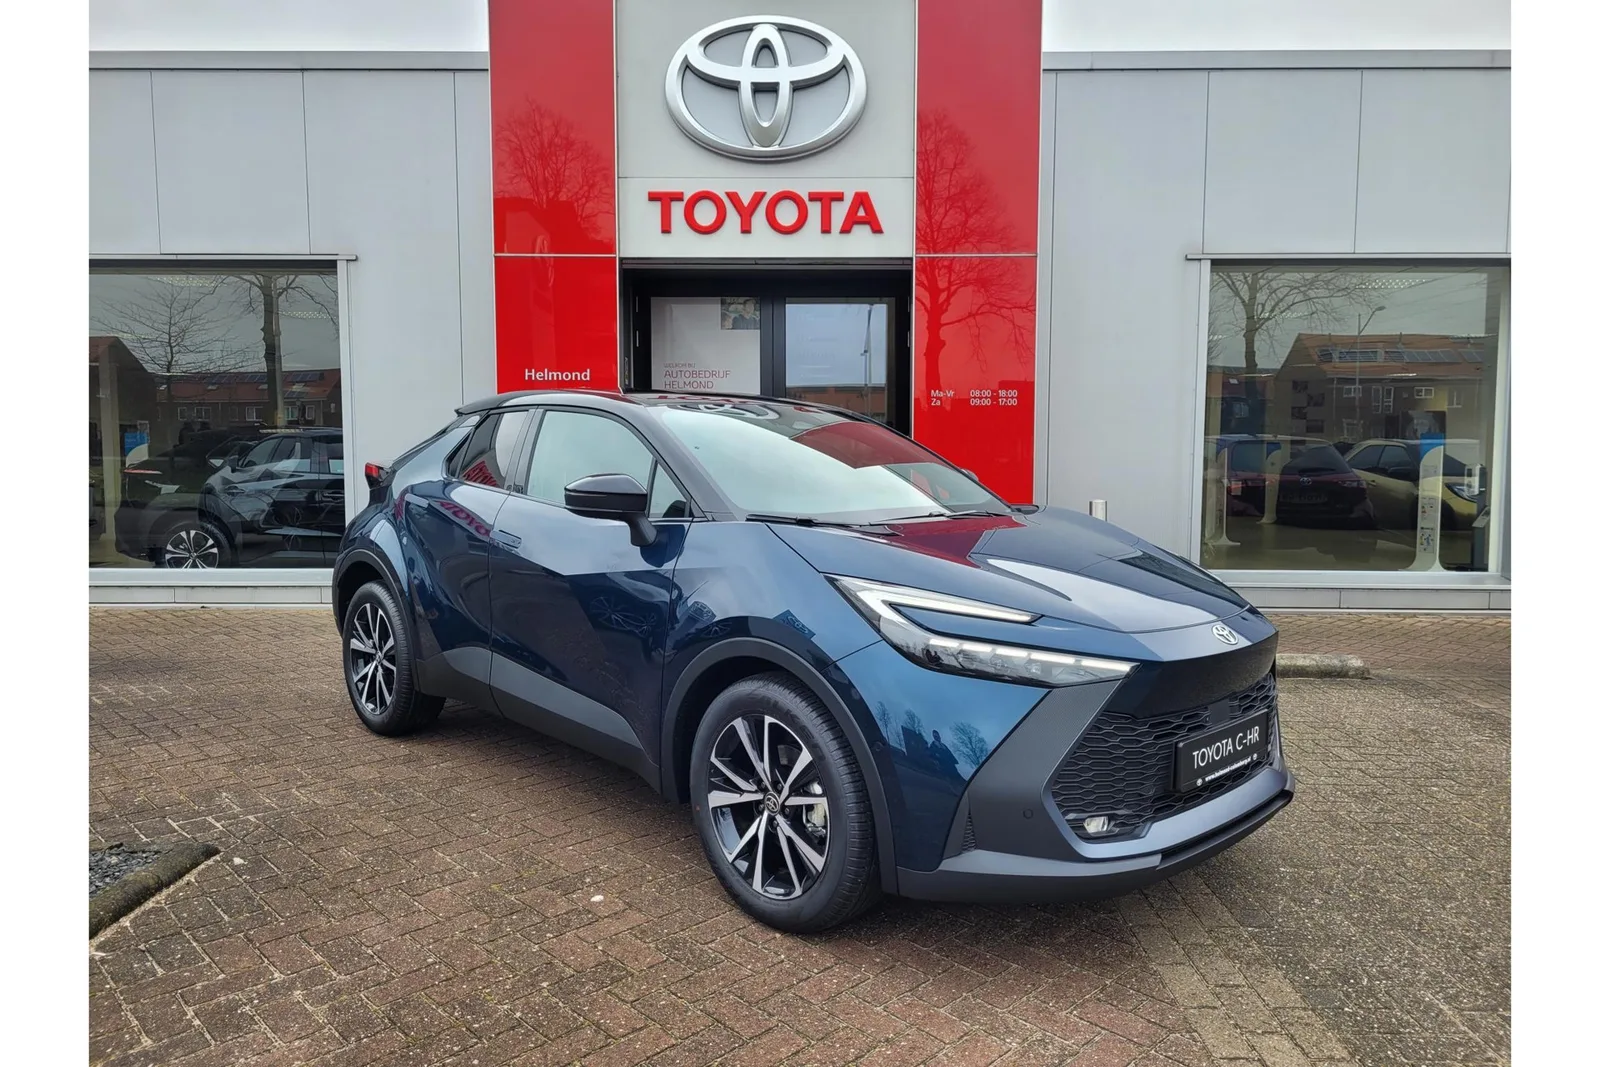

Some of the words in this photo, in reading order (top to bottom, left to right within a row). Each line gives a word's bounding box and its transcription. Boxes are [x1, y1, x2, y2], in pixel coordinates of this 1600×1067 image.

[648, 190, 884, 235] TOYOTA
[525, 368, 590, 381] Helmond
[664, 370, 731, 379] AUTOBEDRIJF
[664, 381, 714, 389] HELMOND
[931, 398, 941, 406] Za
[970, 398, 991, 406] 09:00
[998, 398, 1018, 406] 17:00
[1193, 738, 1233, 768] TOYOTA
[1236, 727, 1259, 749] C-HR
